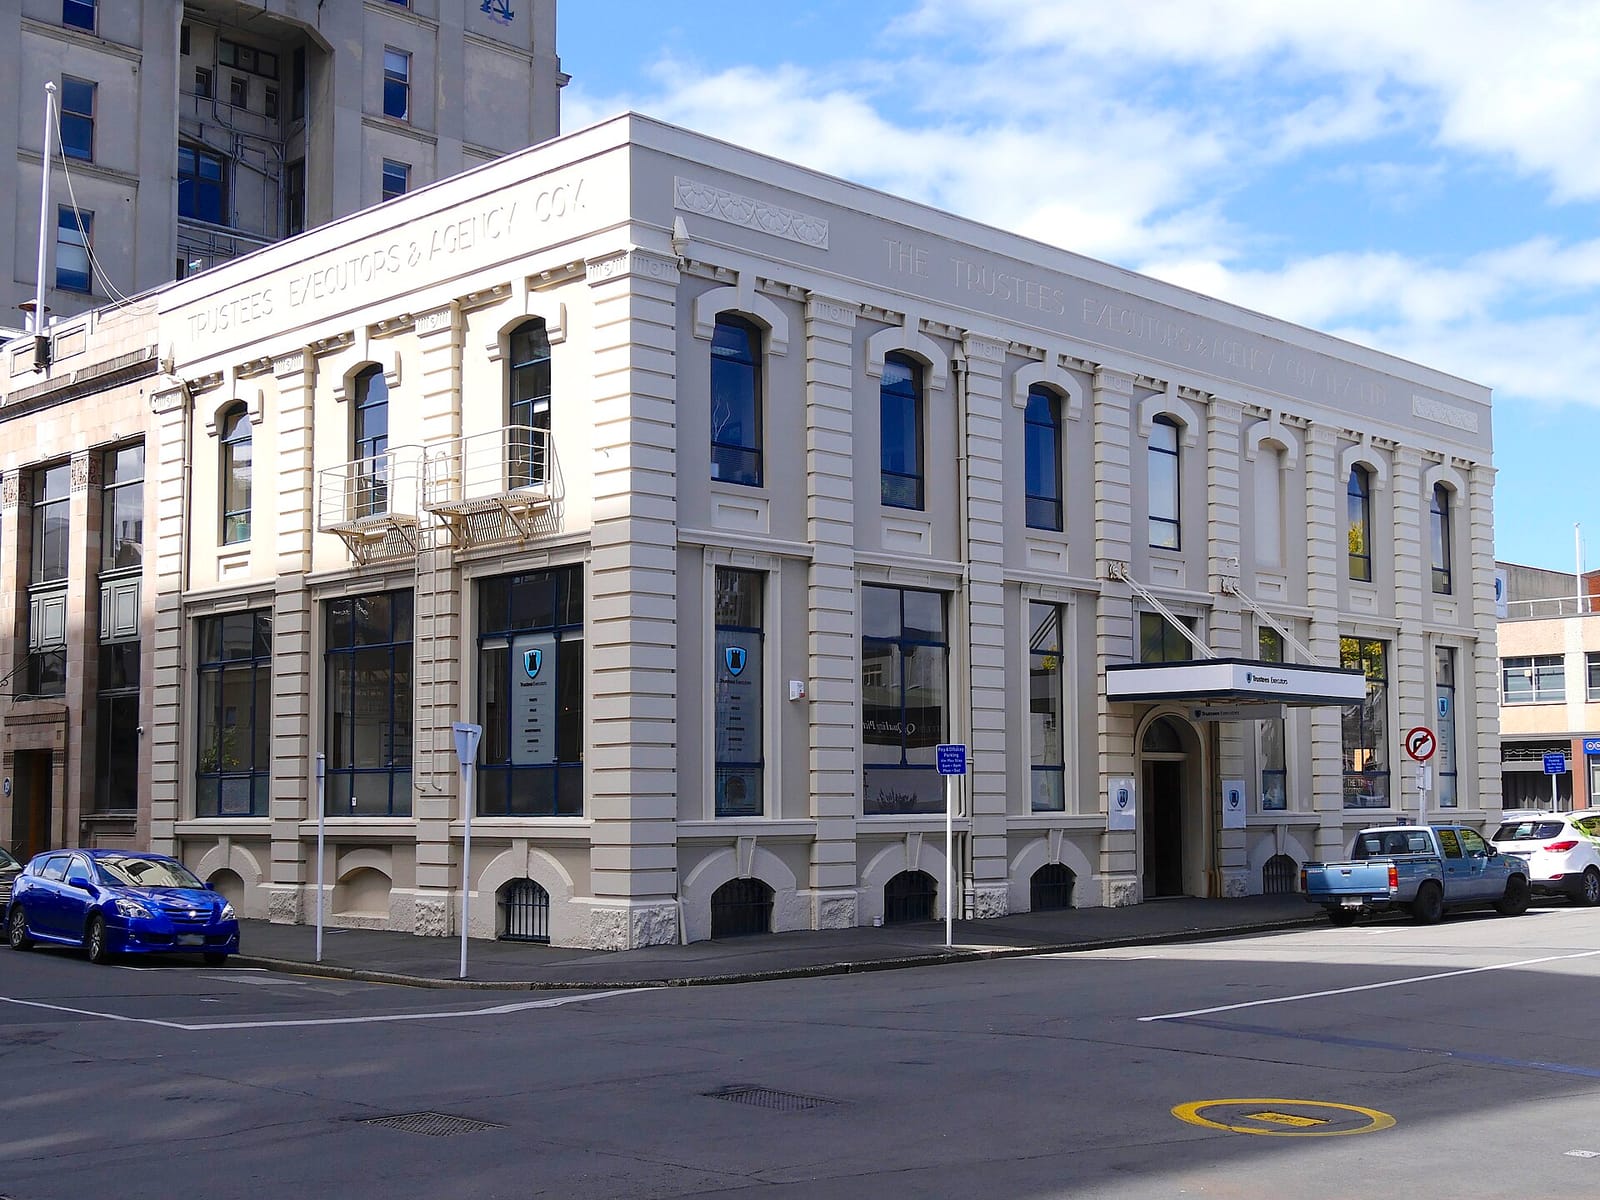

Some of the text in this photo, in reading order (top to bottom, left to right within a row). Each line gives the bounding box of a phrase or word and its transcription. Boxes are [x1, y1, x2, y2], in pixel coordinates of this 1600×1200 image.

[187, 288, 274, 343] TRUSTEES
[289, 245, 401, 309] EXECUTORS
[407, 241, 423, 268] &
[426, 202, 517, 262] AGENCY
[882, 239, 929, 280] THE
[950, 258, 1065, 316] TRUSTEES
[1082, 297, 1193, 353] EXECUTORS
[1210, 336, 1277, 375] AGENCY
[1252, 674, 1270, 684] Trustees
